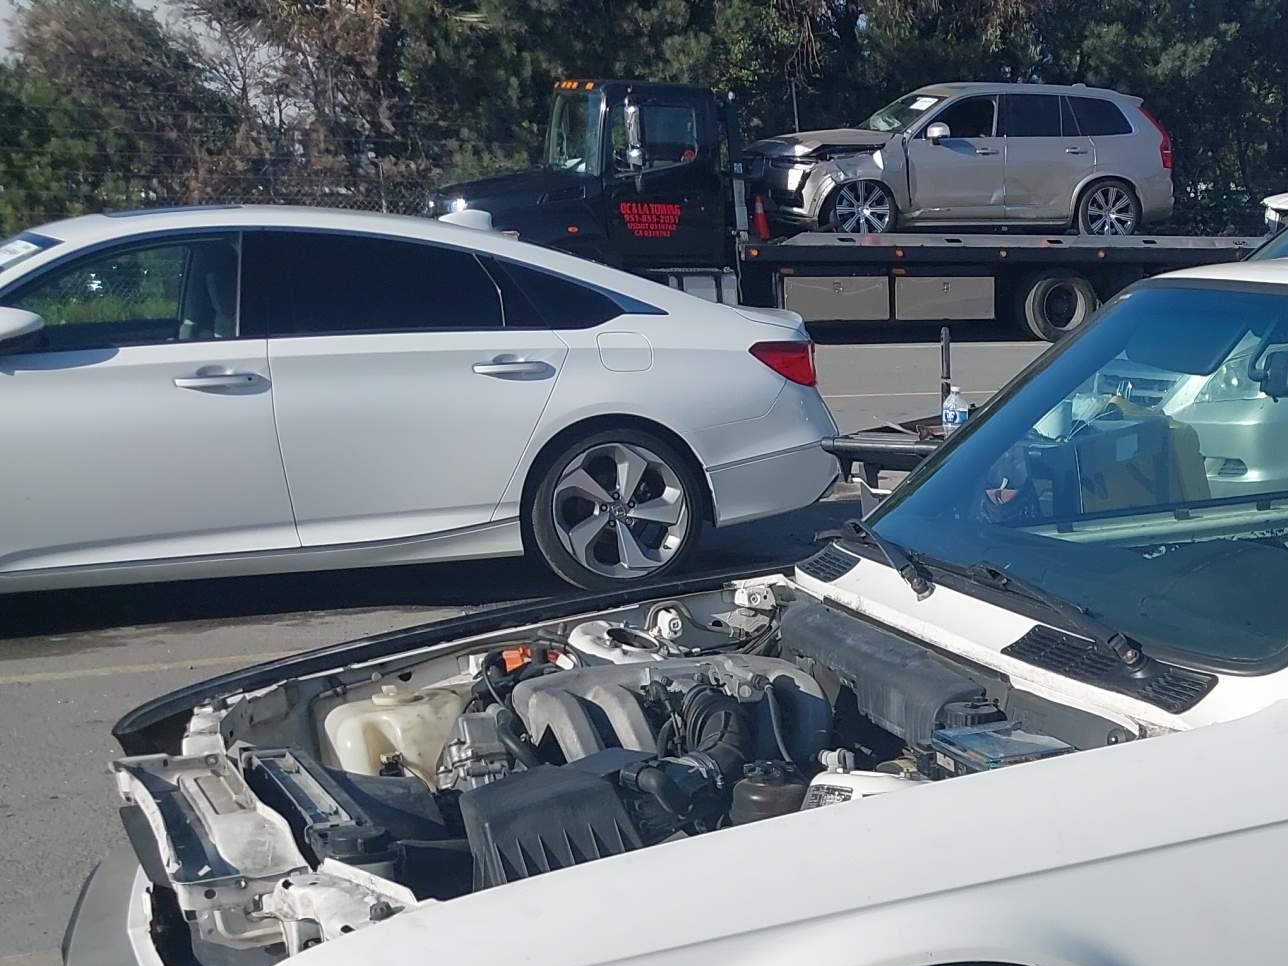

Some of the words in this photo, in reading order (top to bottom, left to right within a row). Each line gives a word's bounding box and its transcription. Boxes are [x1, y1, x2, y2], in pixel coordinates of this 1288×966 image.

[620, 202, 632, 214] OC
[632, 202, 638, 214] &
[638, 203, 650, 214] LA
[651, 204, 681, 215] TOWING
